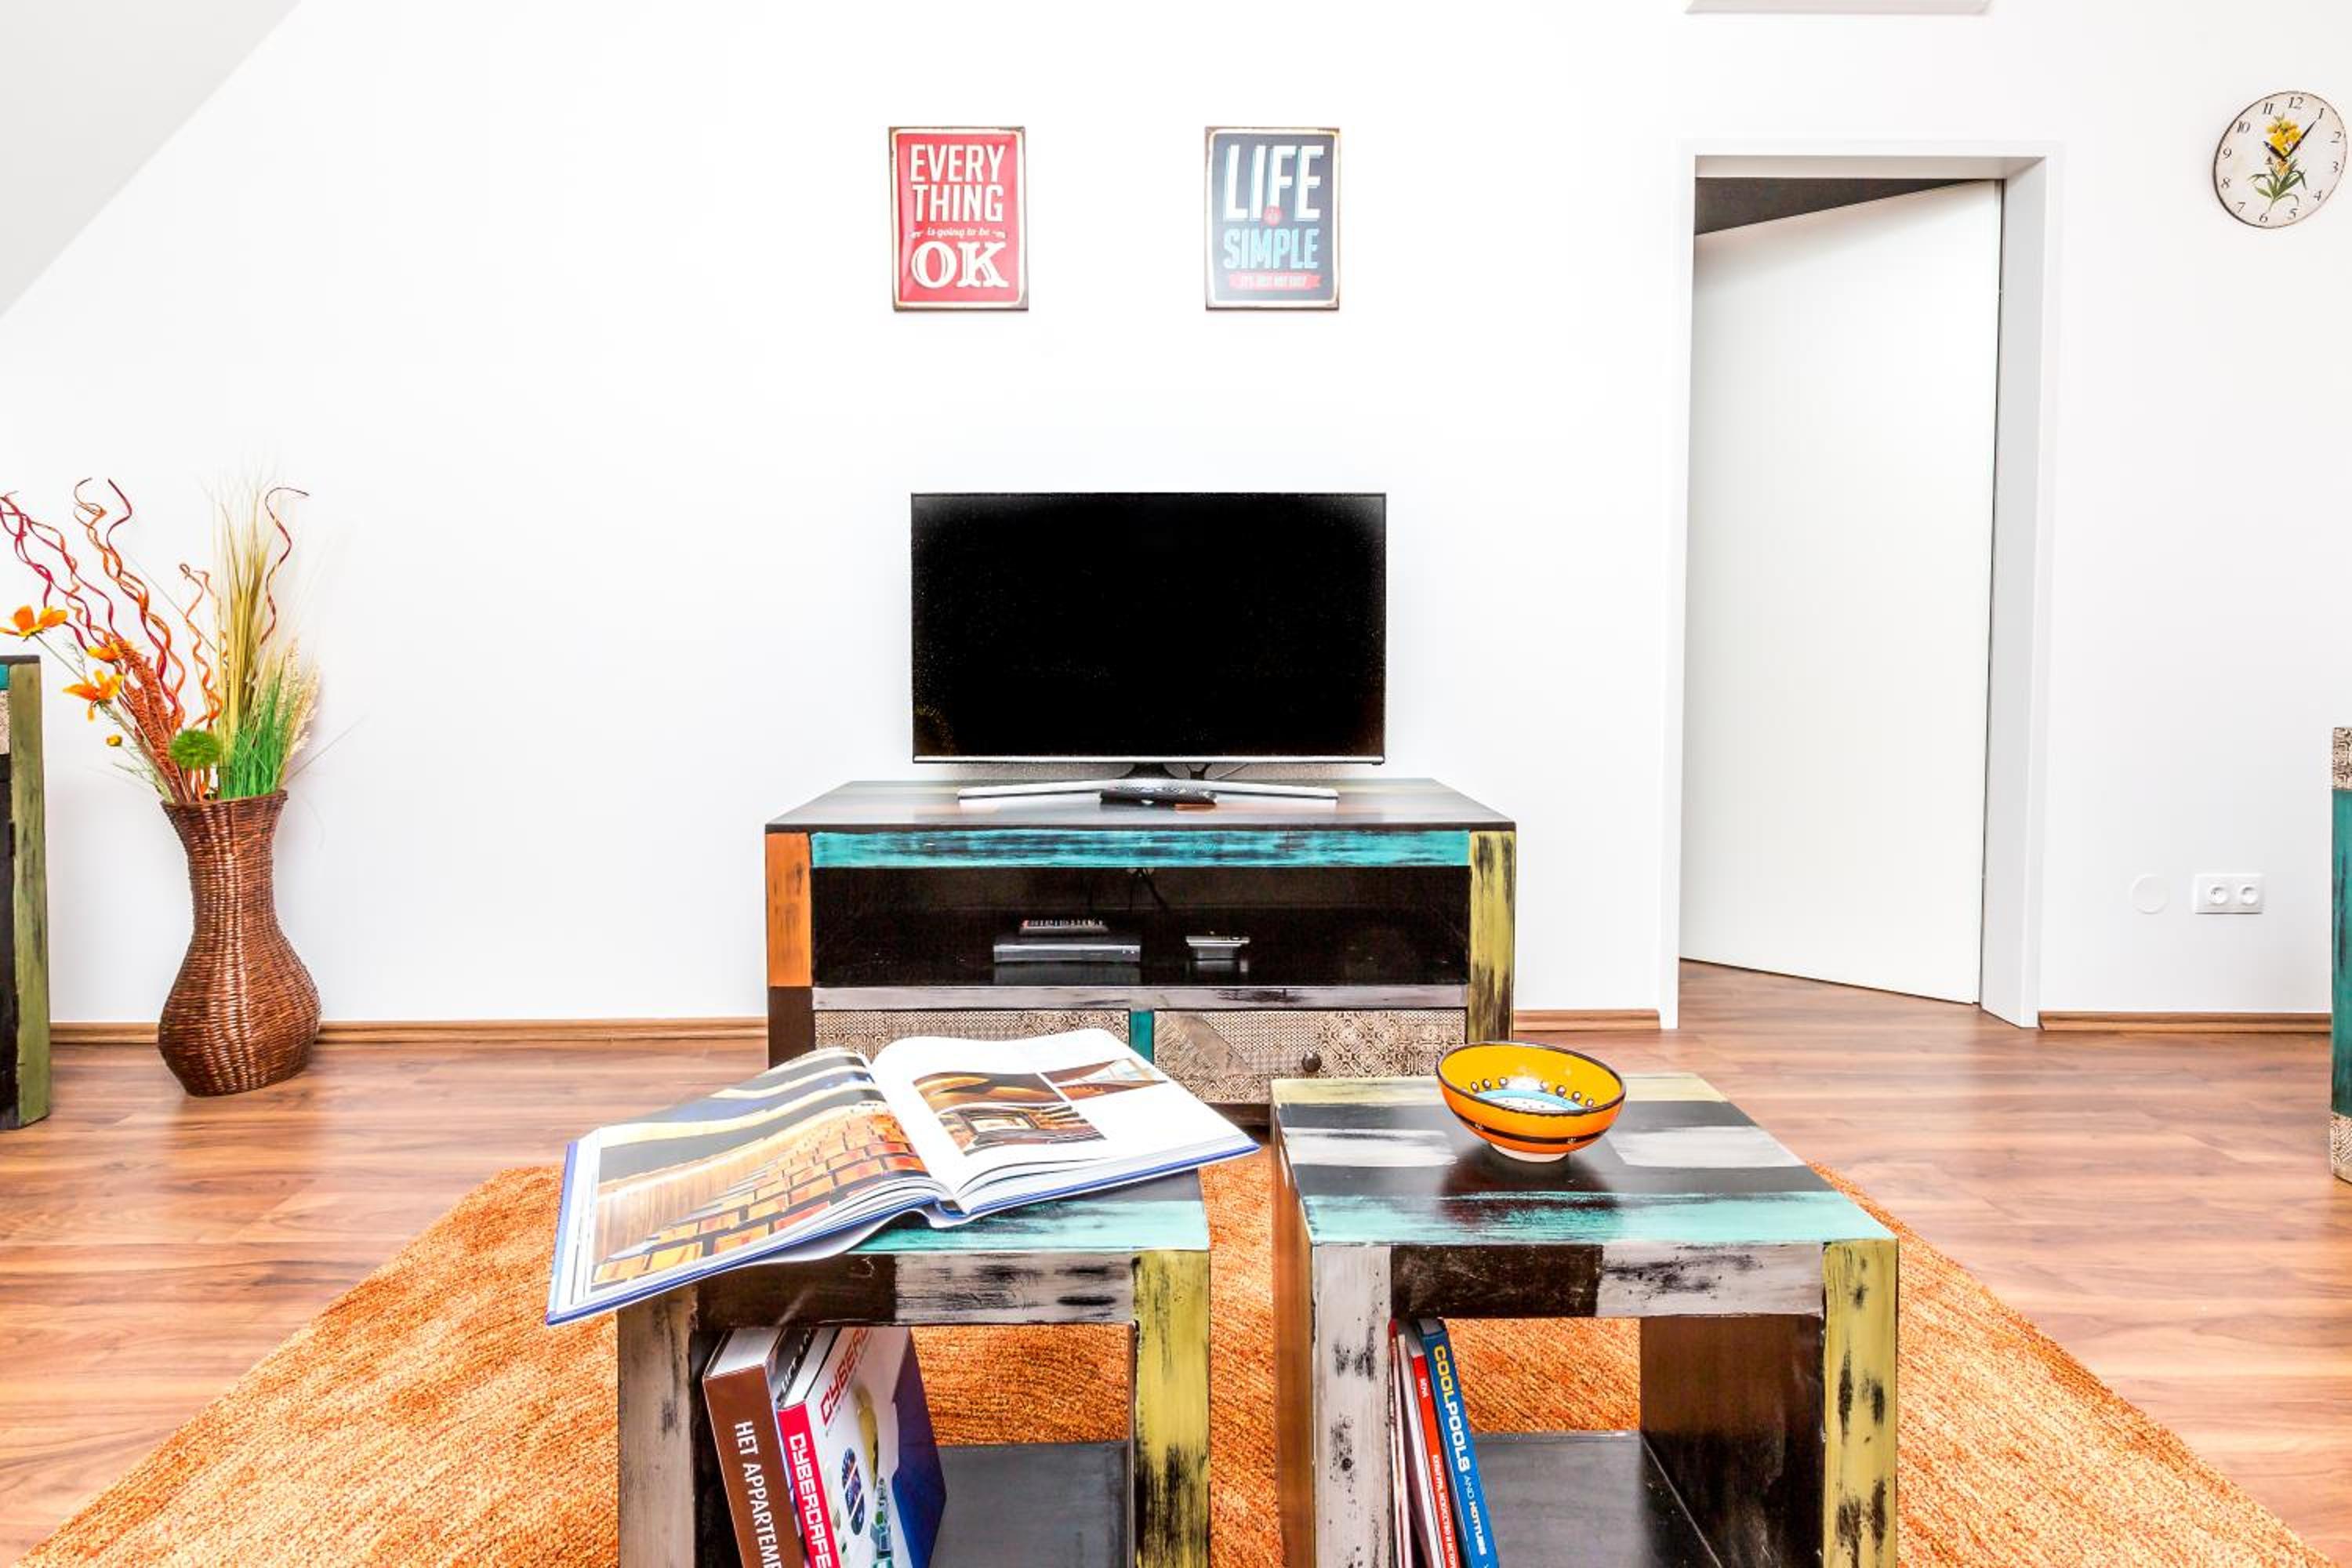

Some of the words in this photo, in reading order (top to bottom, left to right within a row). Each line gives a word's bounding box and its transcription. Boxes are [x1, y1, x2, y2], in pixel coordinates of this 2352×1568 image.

[2263, 103, 2274, 115] 11
[2288, 96, 2304, 110] 12
[2318, 107, 2325, 119] 1
[2236, 121, 2251, 134] 10
[2329, 131, 2342, 143] 2
[2223, 148, 2232, 160] 9
[909, 144, 1006, 183] EVERY
[2332, 161, 2339, 173] 3
[1223, 144, 1325, 222] LIFE
[2220, 177, 2231, 189] 8
[2314, 190, 2323, 201] 4
[912, 184, 1004, 223] THING
[2237, 201, 2246, 214] 7
[2259, 212, 2268, 223] 6
[2288, 208, 2298, 220] 5
[1223, 228, 1320, 269] SIMPLE
[911, 241, 1009, 289] OK
[1434, 1345, 1471, 1472] COOLPOOLS
[735, 1421, 758, 1454] HET
[1464, 1475, 1474, 1499] AND
[789, 1432, 832, 1568] CYBERCAFE
